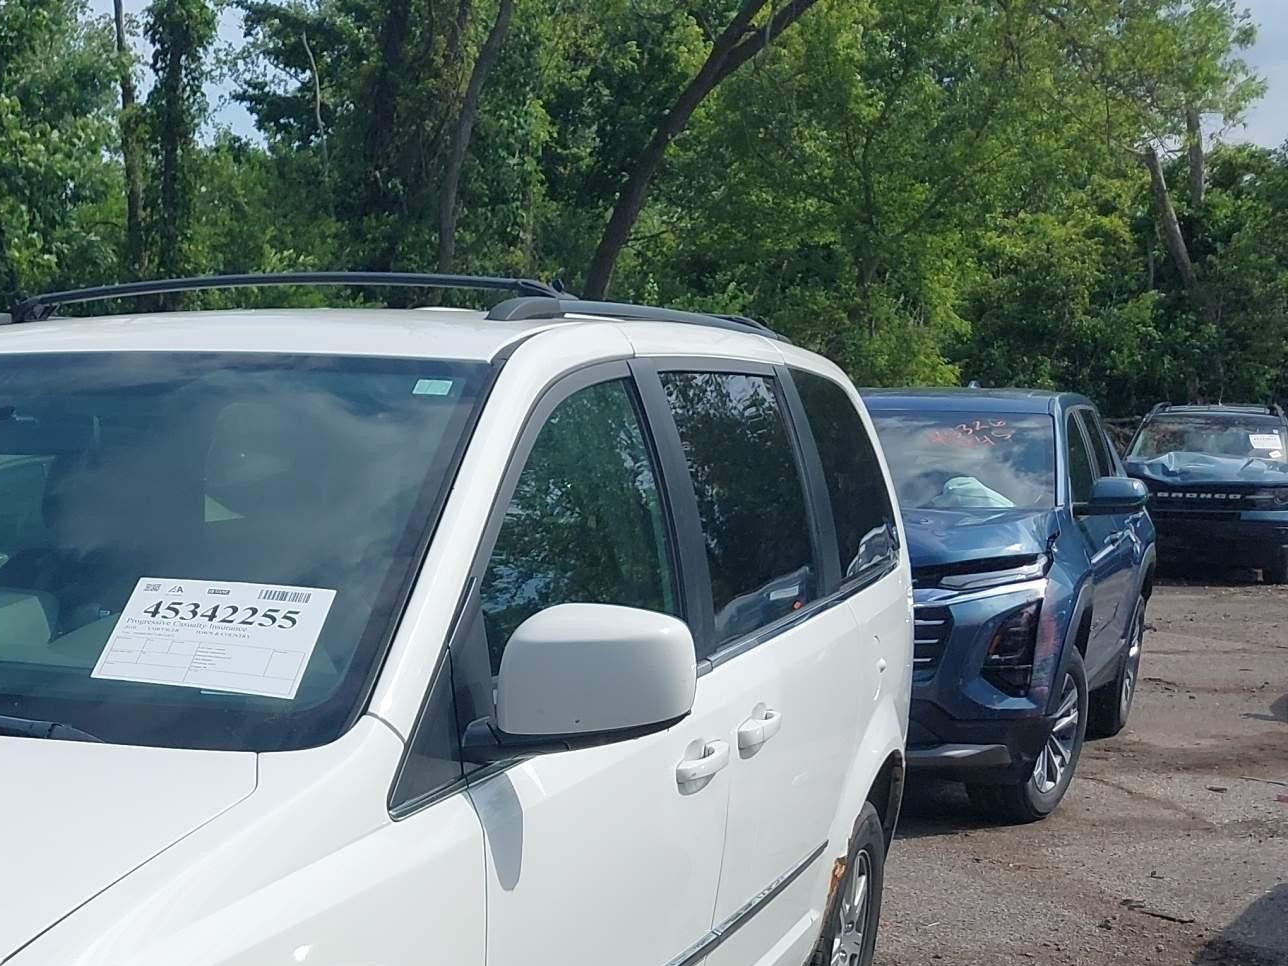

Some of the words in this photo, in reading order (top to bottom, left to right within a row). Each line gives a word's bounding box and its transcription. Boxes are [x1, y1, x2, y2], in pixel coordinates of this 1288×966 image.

[1156, 491, 1242, 500] BRONCO
[143, 600, 302, 630] 45342255
[125, 617, 172, 627] Progressive
[172, 620, 208, 630] Casualty
[209, 623, 248, 633] Insurance
